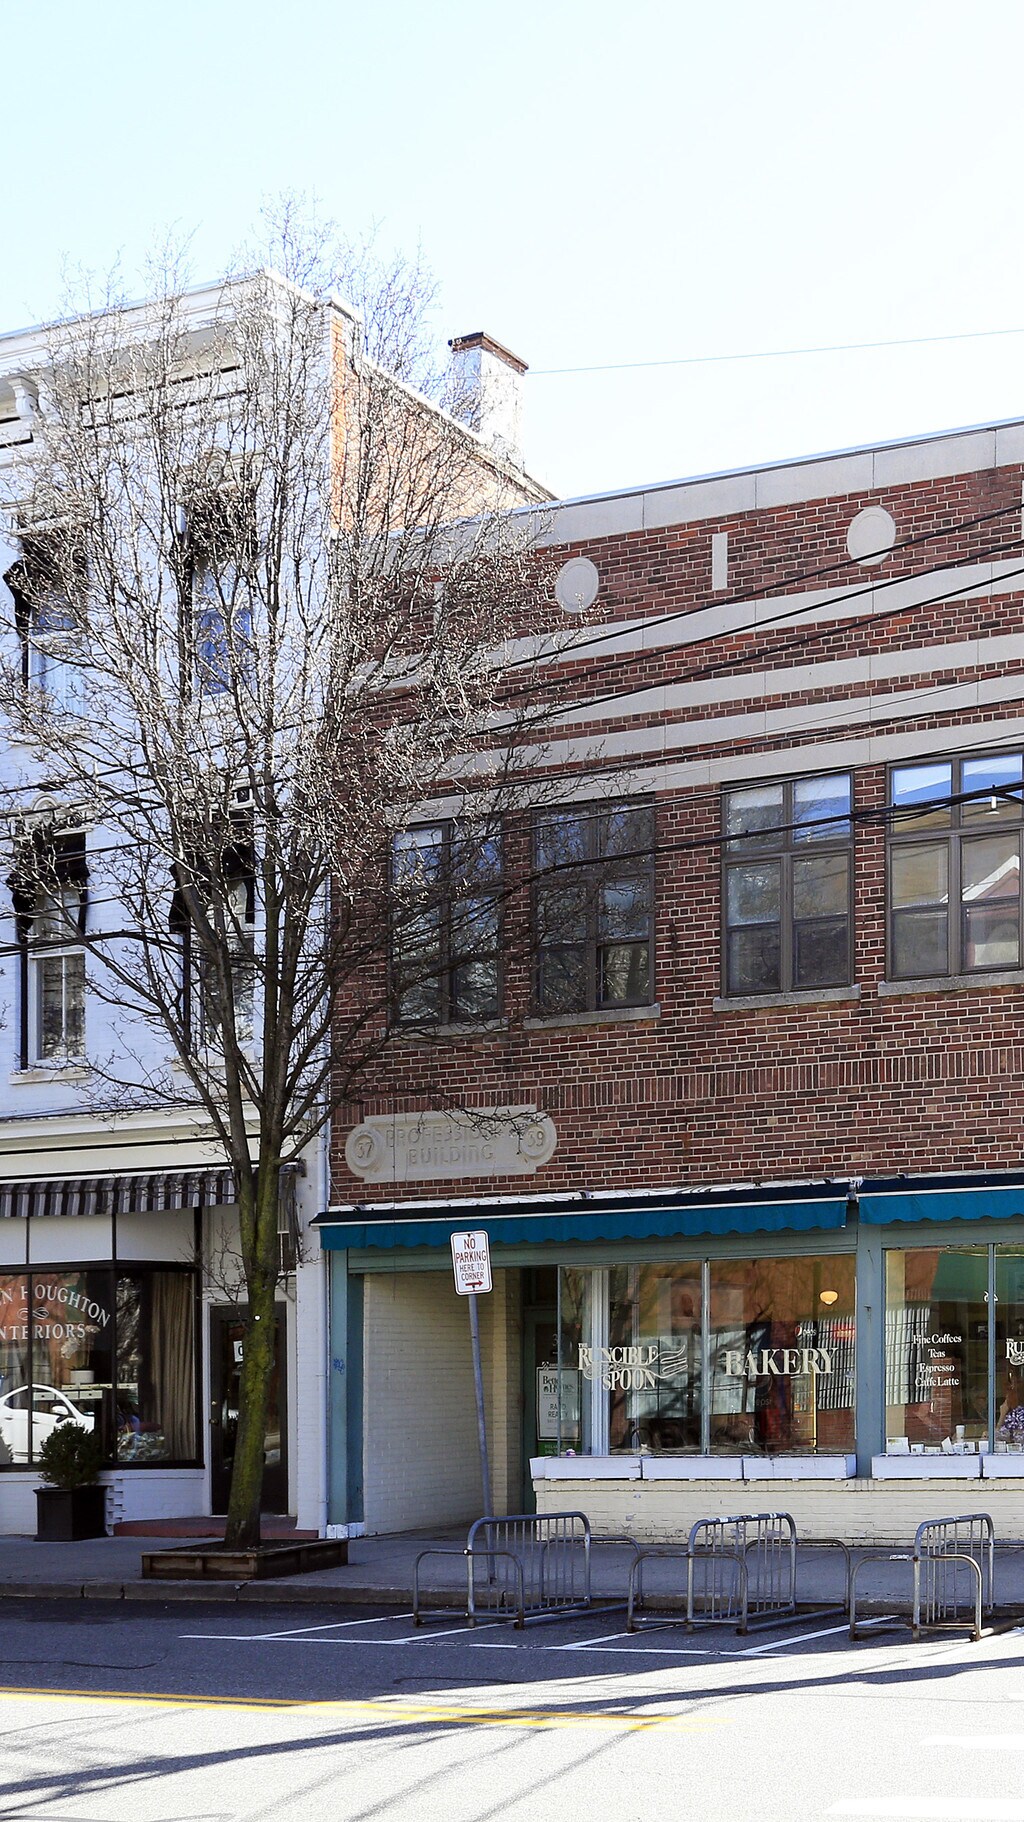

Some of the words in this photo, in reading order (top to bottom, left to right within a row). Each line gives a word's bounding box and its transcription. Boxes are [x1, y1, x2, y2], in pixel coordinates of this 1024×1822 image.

[386, 1120, 514, 1148] PROFESSIO
[527, 1129, 545, 1148] 39
[356, 1141, 373, 1159] 37
[408, 1144, 494, 1166] BUILDING
[463, 1238, 476, 1250] NO
[455, 1250, 487, 1263] PARKING
[460, 1264, 474, 1273] HERE
[477, 1263, 485, 1271] TO
[461, 1272, 485, 1281] CORNER
[20, 1284, 111, 1328] HOUGHTON
[913, 1334, 931, 1344] Fine
[931, 1333, 962, 1344] Coffees
[578, 1345, 658, 1370] RUNCIBLE
[928, 1348, 946, 1358] Teas
[724, 1347, 838, 1376] BAKERY
[919, 1362, 955, 1373] Espresso
[602, 1368, 656, 1391] SPOON
[937, 1377, 960, 1386] Latte
